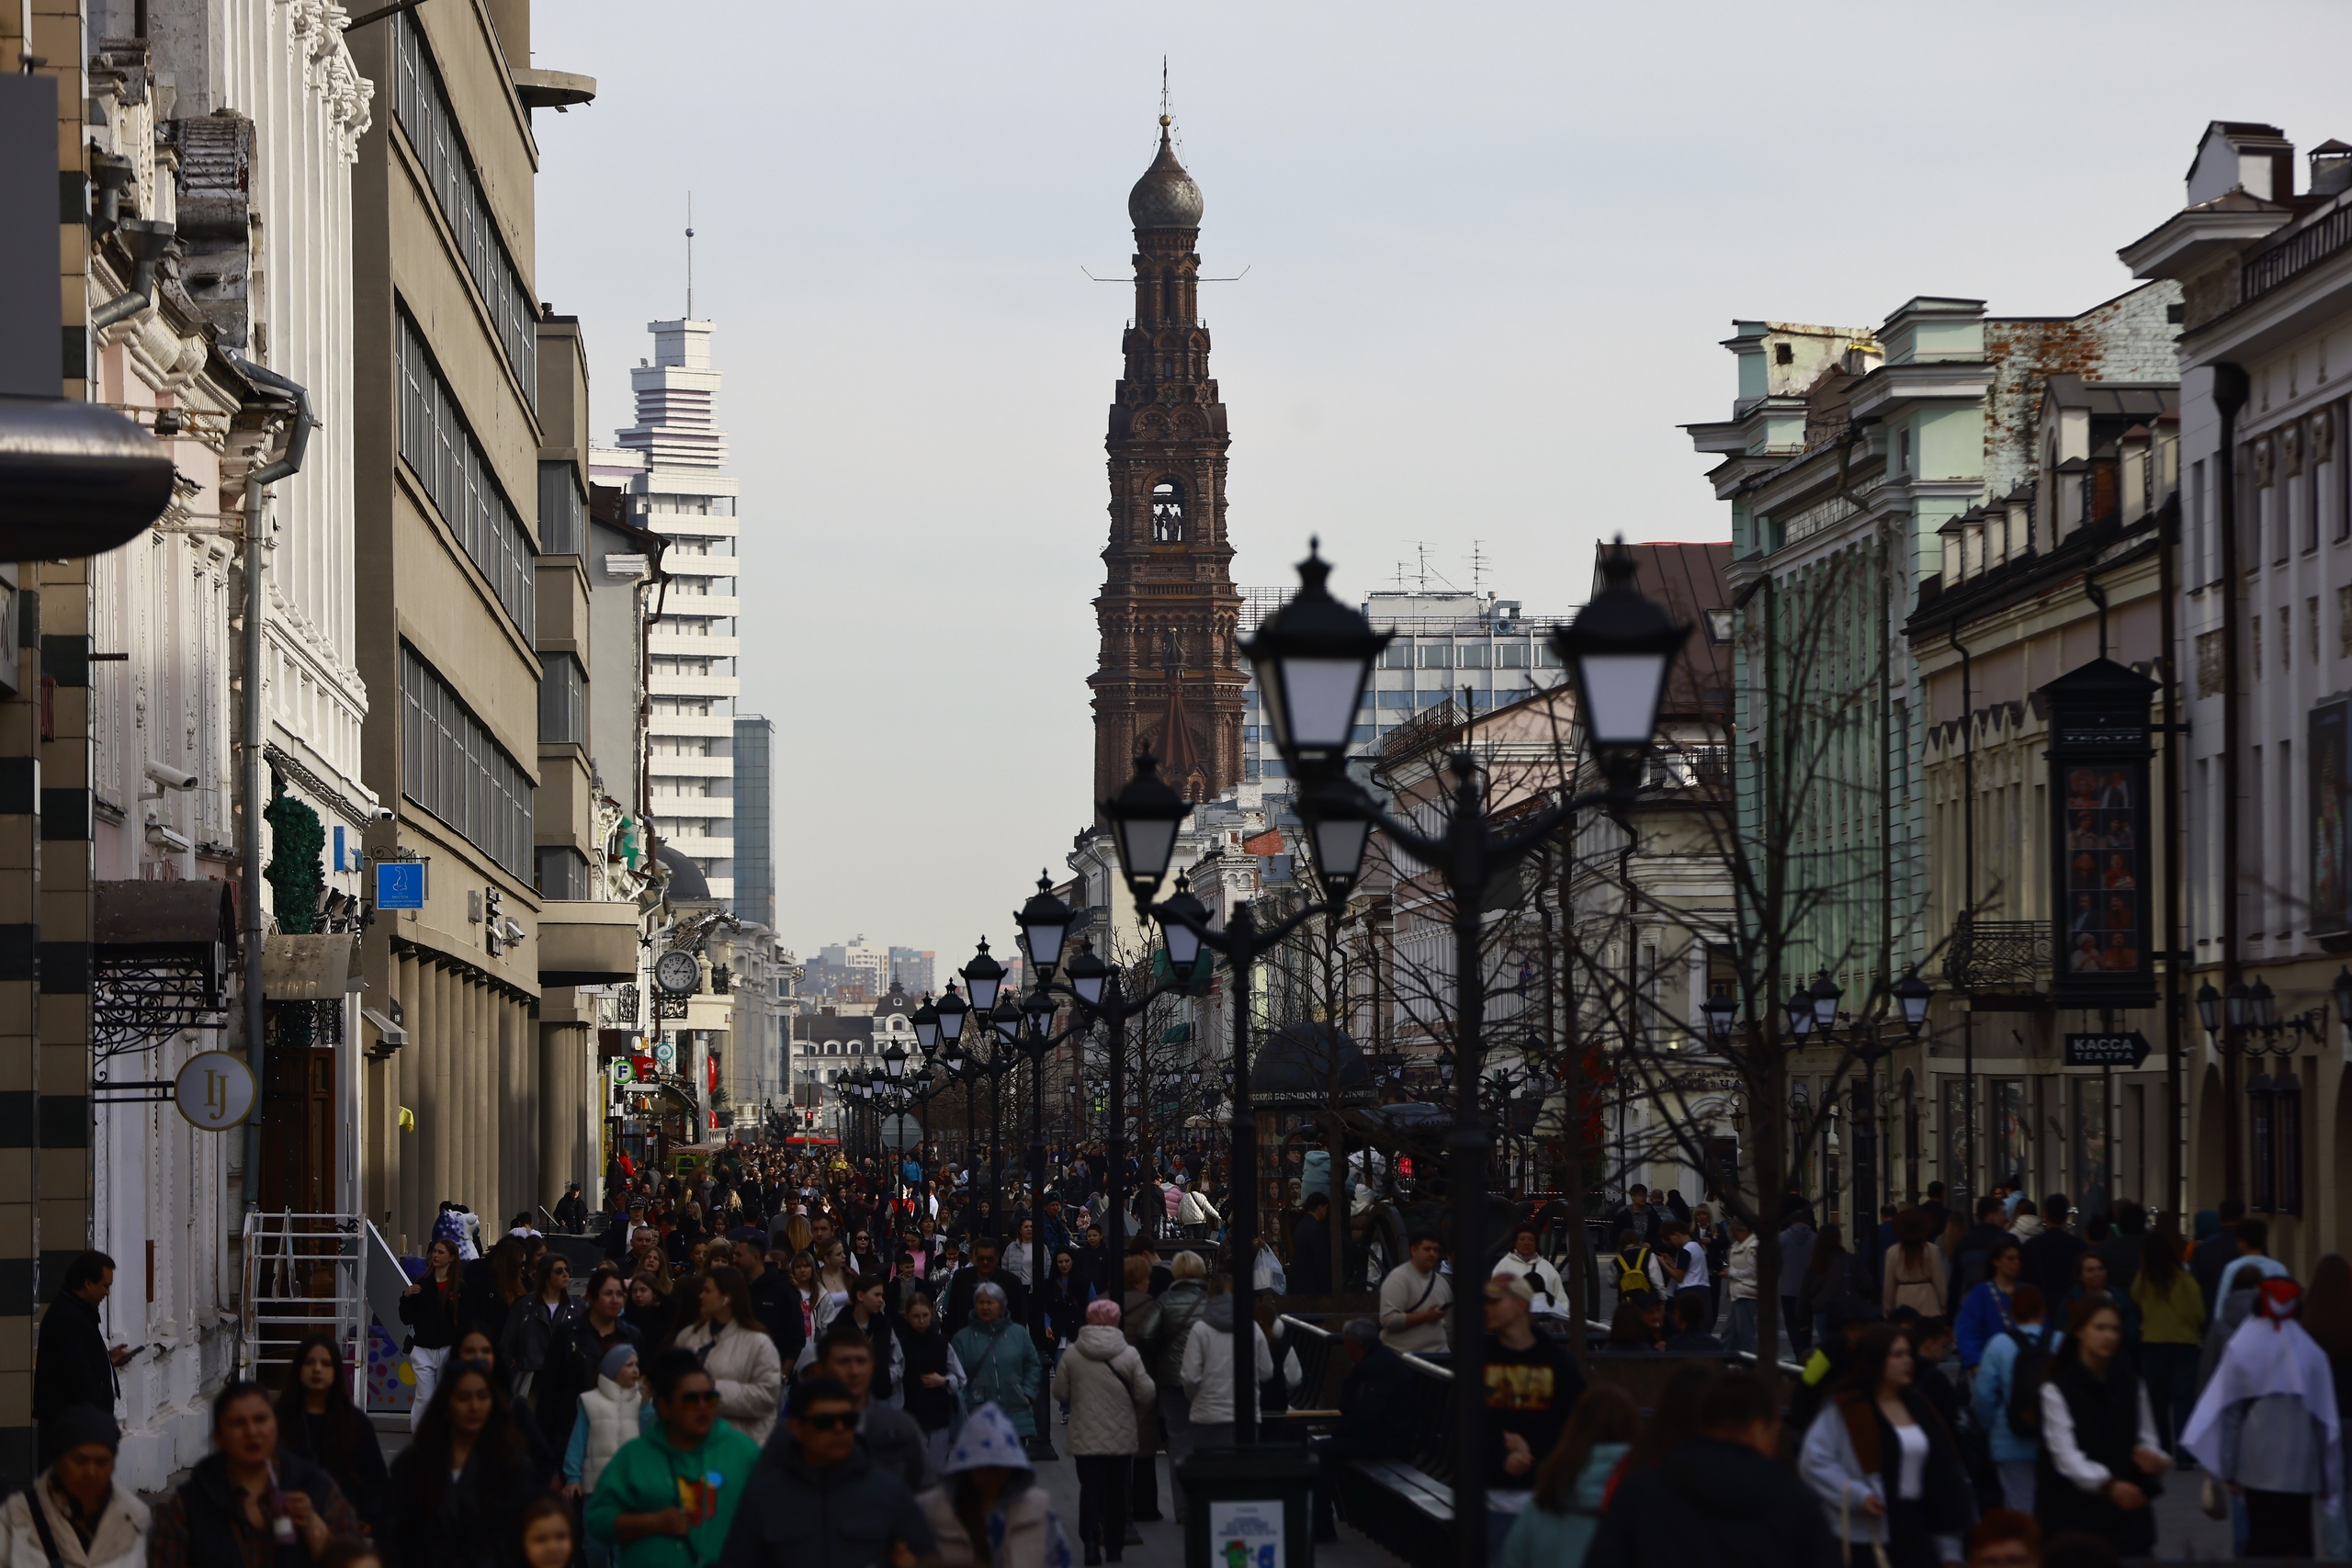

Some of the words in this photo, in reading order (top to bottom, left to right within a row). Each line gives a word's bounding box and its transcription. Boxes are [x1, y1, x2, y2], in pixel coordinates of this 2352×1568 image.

[2073, 1039, 2134, 1050] КАССА
[2074, 1052, 2135, 1060] ТЕАТРА
[618, 1066, 628, 1078] F
[1274, 1089, 1317, 1100] БОЛЬШОЙ
